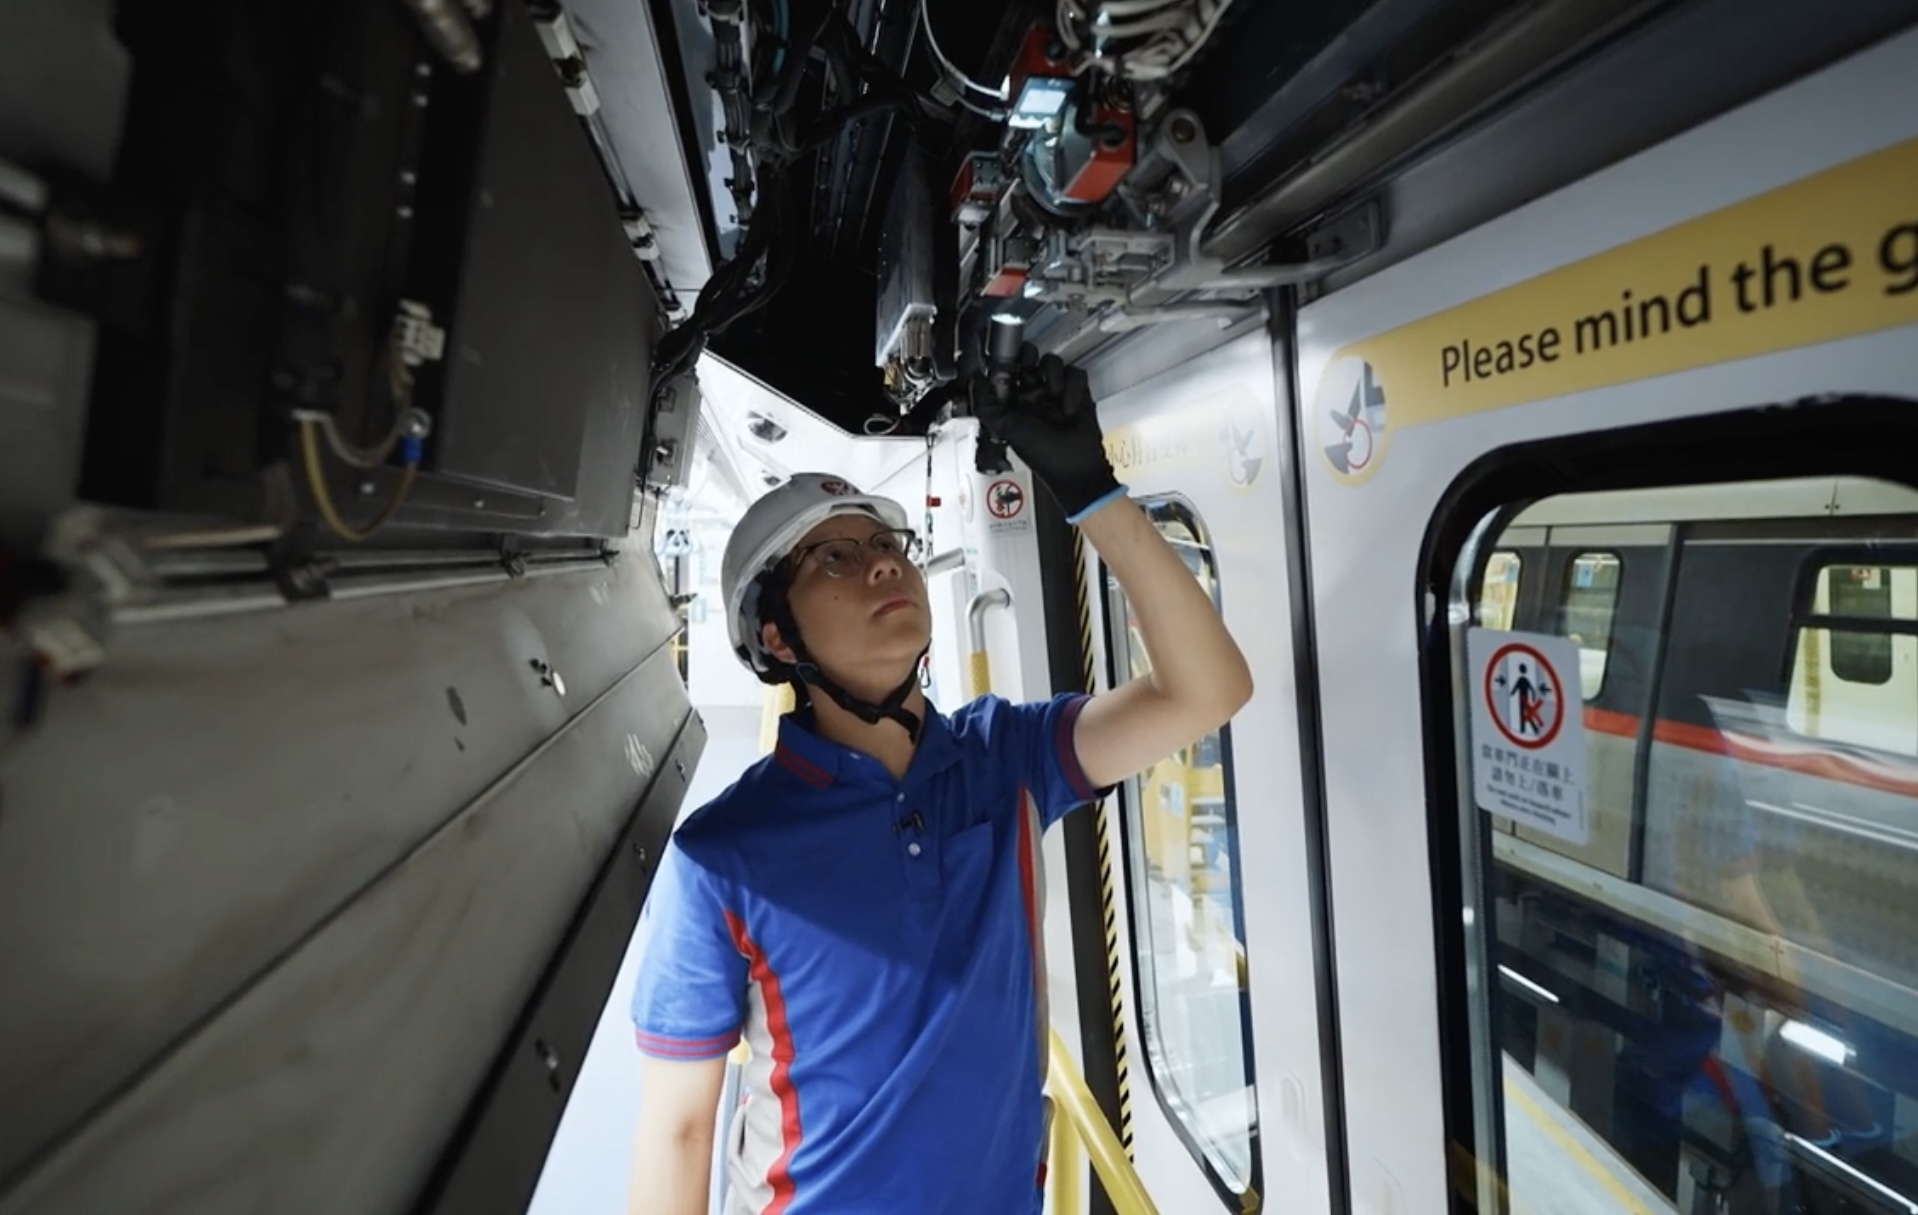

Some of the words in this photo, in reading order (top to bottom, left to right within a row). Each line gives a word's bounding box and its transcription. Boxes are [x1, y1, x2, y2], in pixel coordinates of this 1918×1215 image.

[1441, 326, 1561, 388] Please
[1574, 264, 1712, 355] mind
[1729, 243, 1853, 315] the
